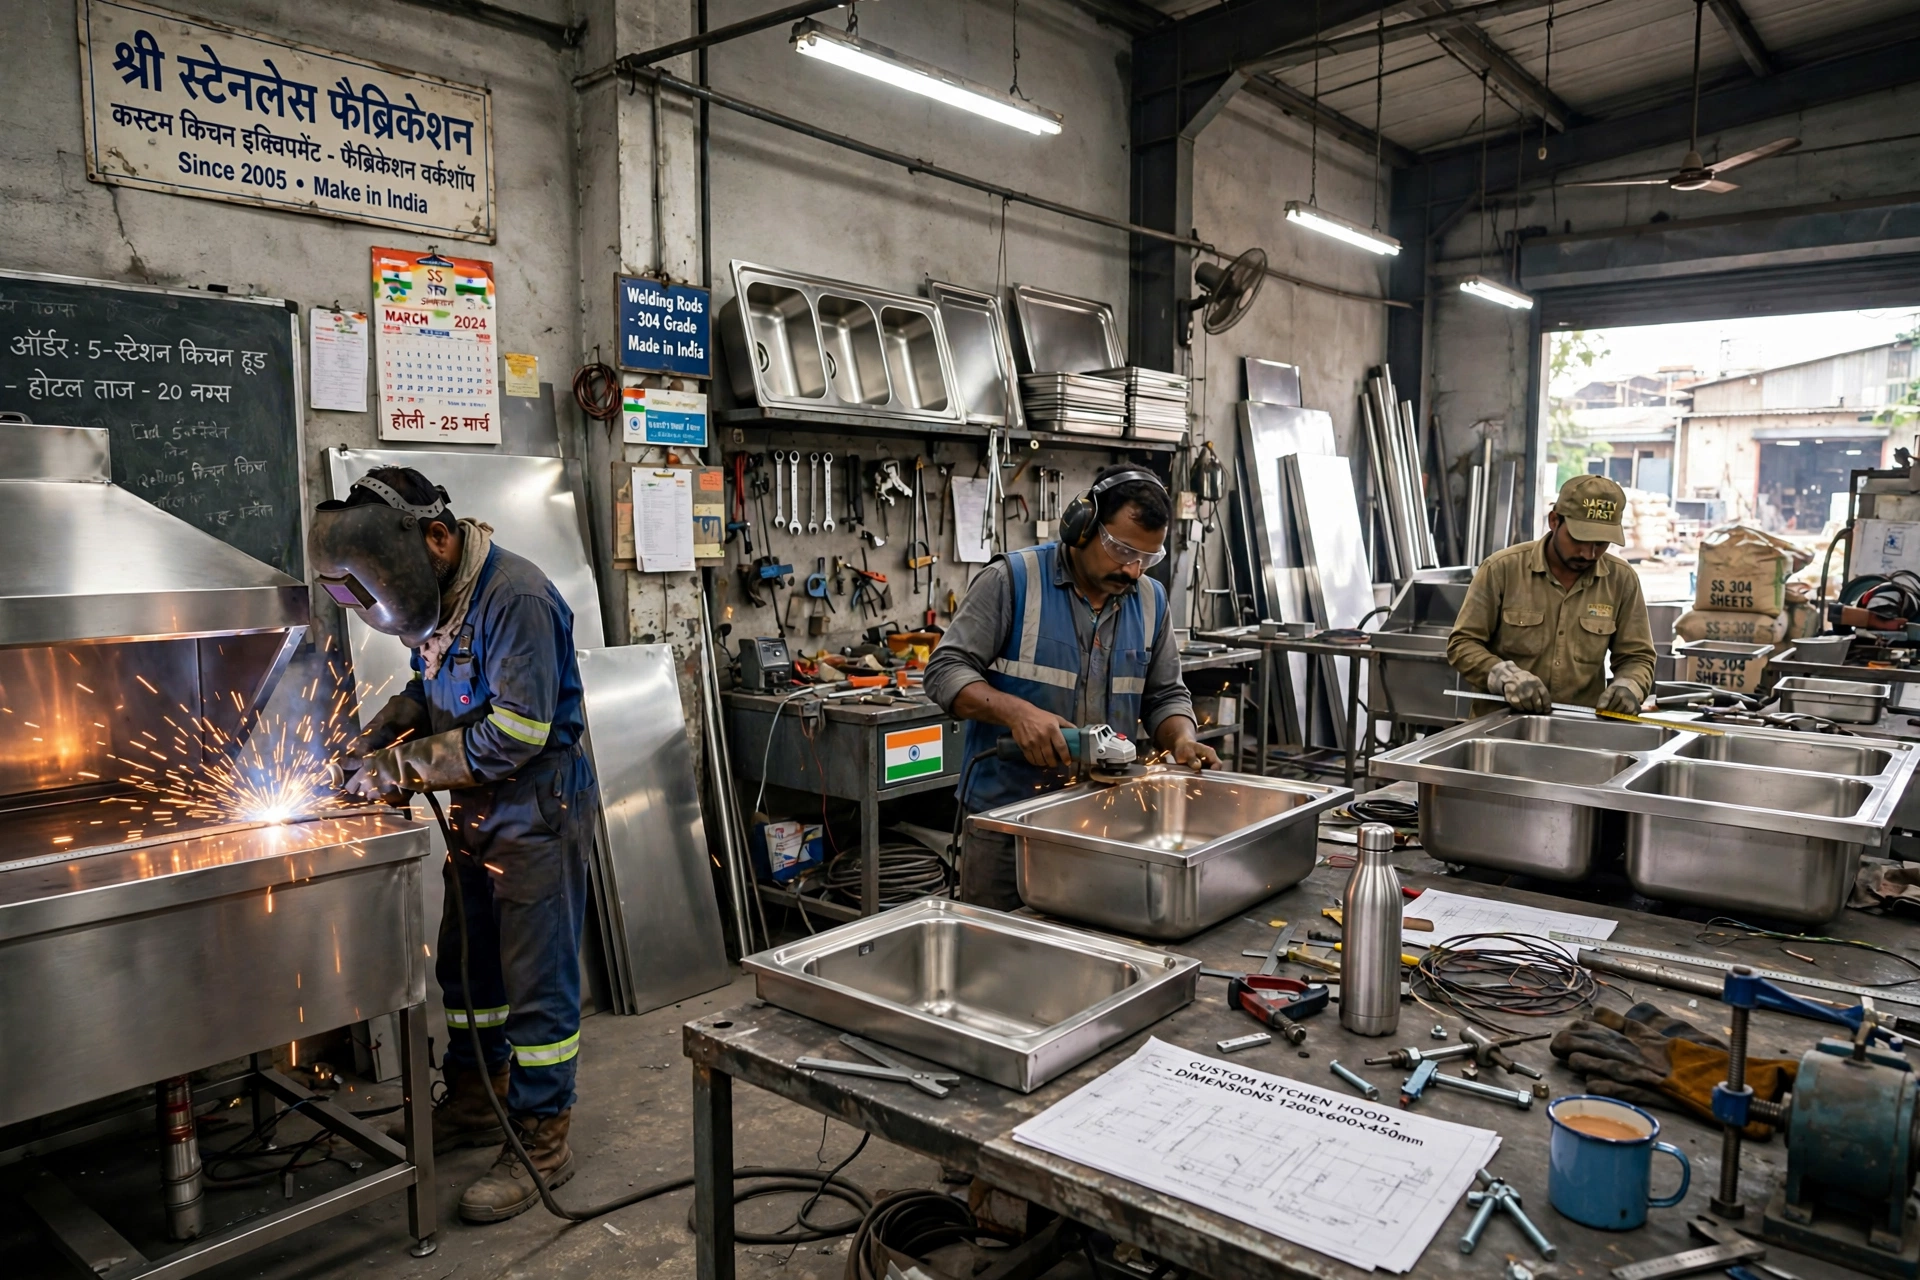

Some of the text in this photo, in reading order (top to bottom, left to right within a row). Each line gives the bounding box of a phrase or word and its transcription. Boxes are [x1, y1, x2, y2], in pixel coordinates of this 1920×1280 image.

[112, 29, 474, 156] श्री स्टेनलेस फैब्रिकेशन
[111, 102, 174, 136] कस्टम
[179, 108, 236, 147] किचन
[340, 140, 416, 181] फैब्रिकेशन
[420, 159, 476, 193] वर्कशॉप
[178, 151, 235, 181] Since
[241, 162, 288, 190] 2005
[313, 175, 361, 203] Make
[366, 184, 382, 207] in
[387, 188, 428, 214] India
[626, 286, 704, 314] Welding Rods
[385, 309, 487, 330] MARCH 2024
[637, 310, 661, 330] 304
[663, 314, 698, 335] Grade
[178, 338, 235, 367] किचन
[241, 350, 268, 376] हूड
[628, 334, 704, 360] Made in India
[27, 368, 85, 400] होटल
[94, 380, 136, 400] ताज
[158, 382, 183, 401] 20
[390, 408, 425, 430] होली
[440, 415, 459, 431] 25
[462, 412, 490, 432] मार्च
[1586, 509, 1615, 521] FIRST
[1711, 579, 1752, 594] SS 304
[1709, 592, 1754, 608] SHEETS
[1697, 657, 1714, 670] SS
[1696, 670, 1745, 688] SHEETS
[1189, 1061, 1257, 1087] CUSTOM
[1260, 1081, 1333, 1107] KITCHEN
[1337, 1103, 1390, 1125] HOOD
[1174, 1068, 1275, 1103] DIMENSIONS
[1279, 1098, 1424, 1147] 1200x600x450mm
